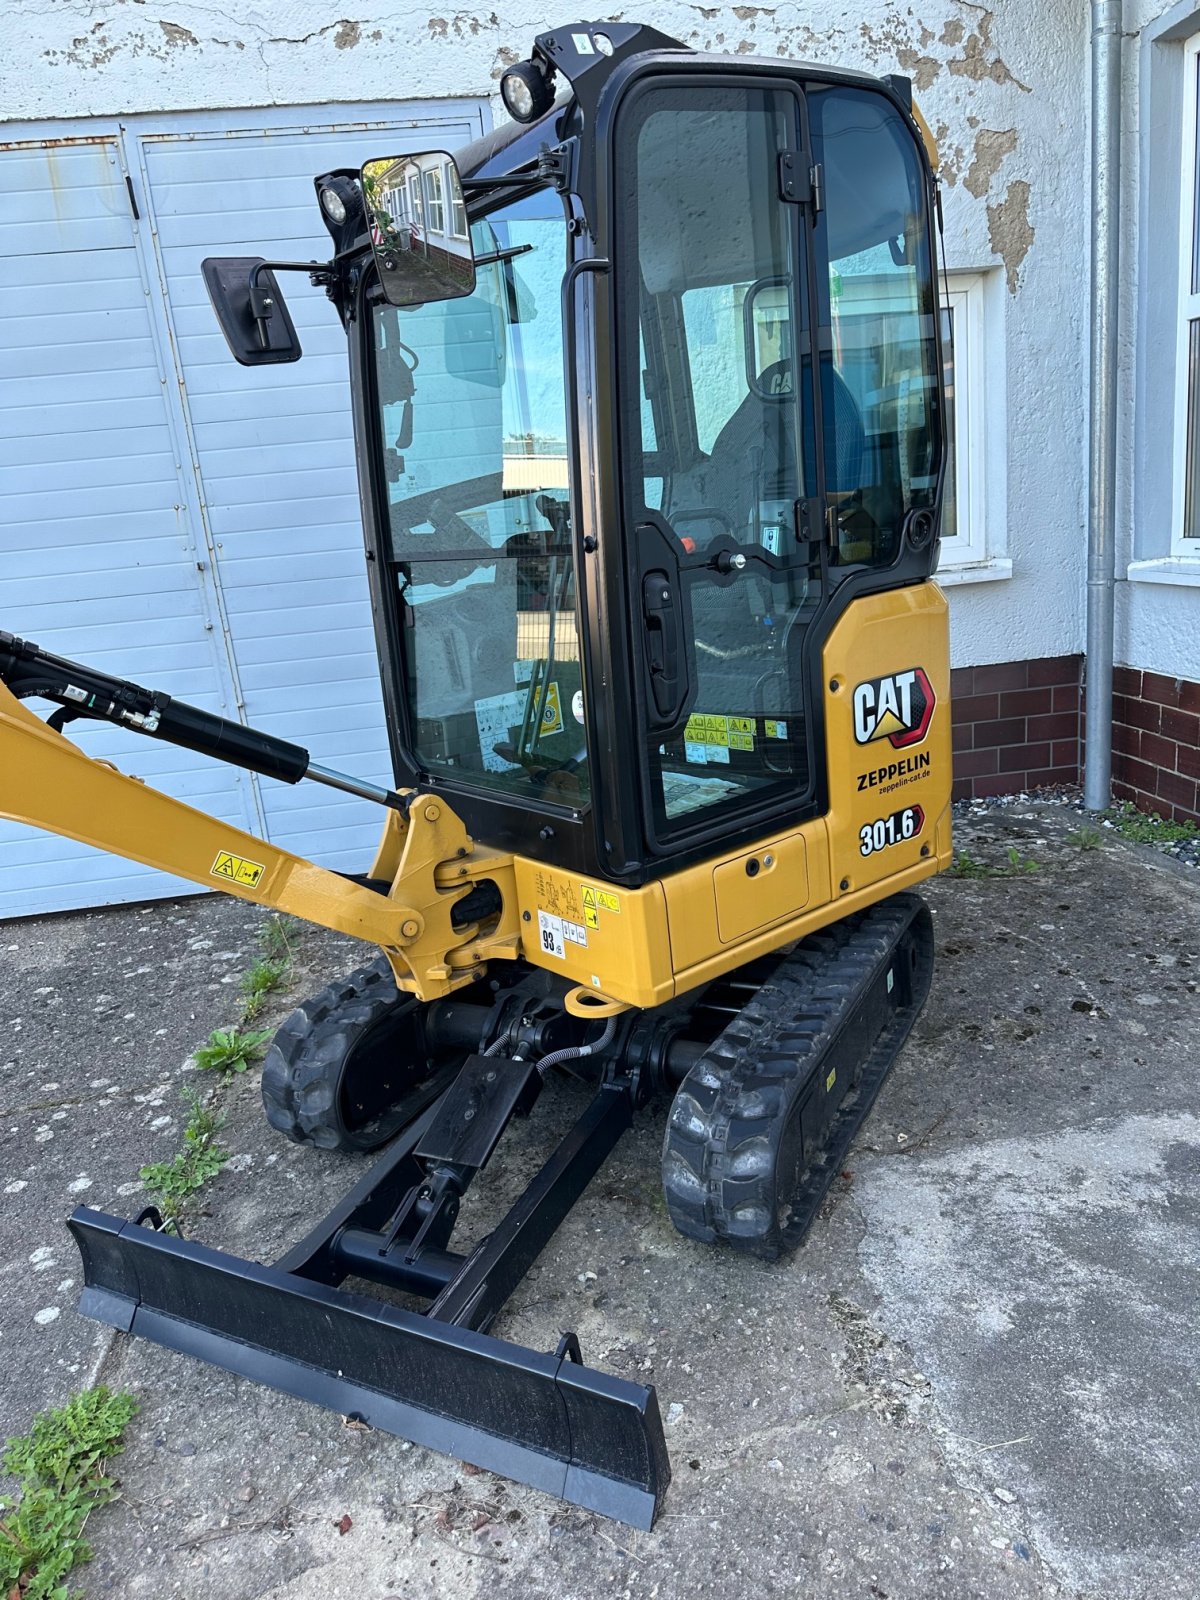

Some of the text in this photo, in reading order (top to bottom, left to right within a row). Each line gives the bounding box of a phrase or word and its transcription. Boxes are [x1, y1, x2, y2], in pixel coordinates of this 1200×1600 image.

[770, 371, 792, 394] CA
[854, 671, 915, 743] CAT
[857, 751, 930, 791] ZEPPELIN
[878, 769, 930, 795] zeppelin-cat.de
[860, 809, 914, 856] 301.6
[542, 930, 555, 951] 93
